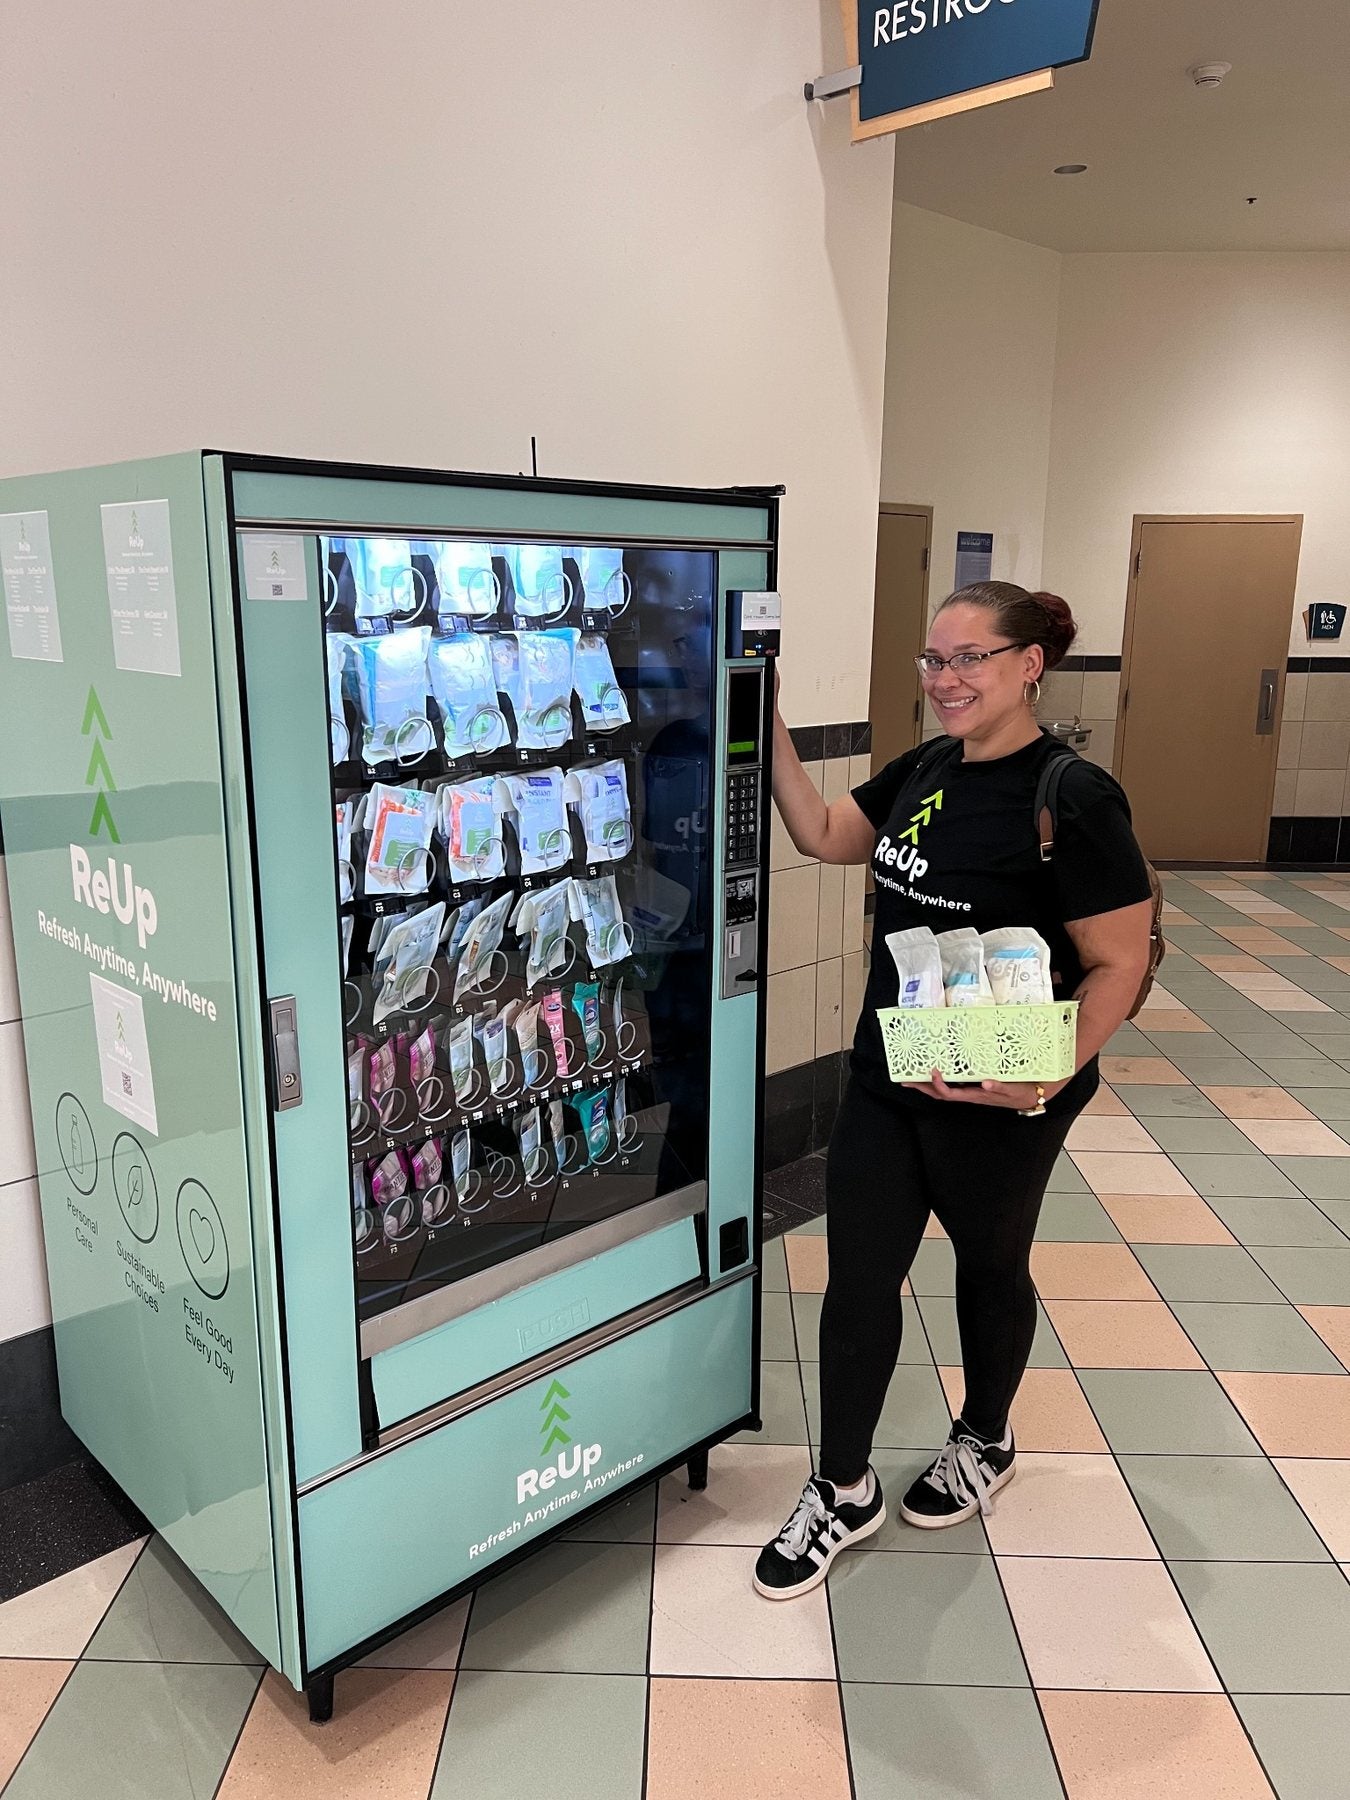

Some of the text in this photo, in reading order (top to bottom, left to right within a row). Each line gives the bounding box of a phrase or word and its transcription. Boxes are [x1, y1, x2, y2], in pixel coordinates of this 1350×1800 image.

[873, 0, 1016, 48] RESTR
[874, 835, 929, 882] ReUp
[70, 843, 158, 949] ReUp
[875, 871, 972, 911] Anytime, Anywhere
[38, 910, 81, 953] Refresh
[83, 933, 140, 986] Anytime,
[142, 962, 217, 1022] Anywhere
[550, 1024, 560, 1033] 2X
[66, 1197, 99, 1236] Personal
[75, 1226, 93, 1253] Care
[116, 1239, 166, 1295] Sustainable
[124, 1270, 159, 1313] Choices
[183, 1297, 233, 1354] Feel Good
[522, 1302, 586, 1348] PUSH
[185, 1324, 235, 1384] Every Day
[516, 1441, 602, 1505] ReUp
[469, 1452, 644, 1560] Refresh Anytime, Anywhere
